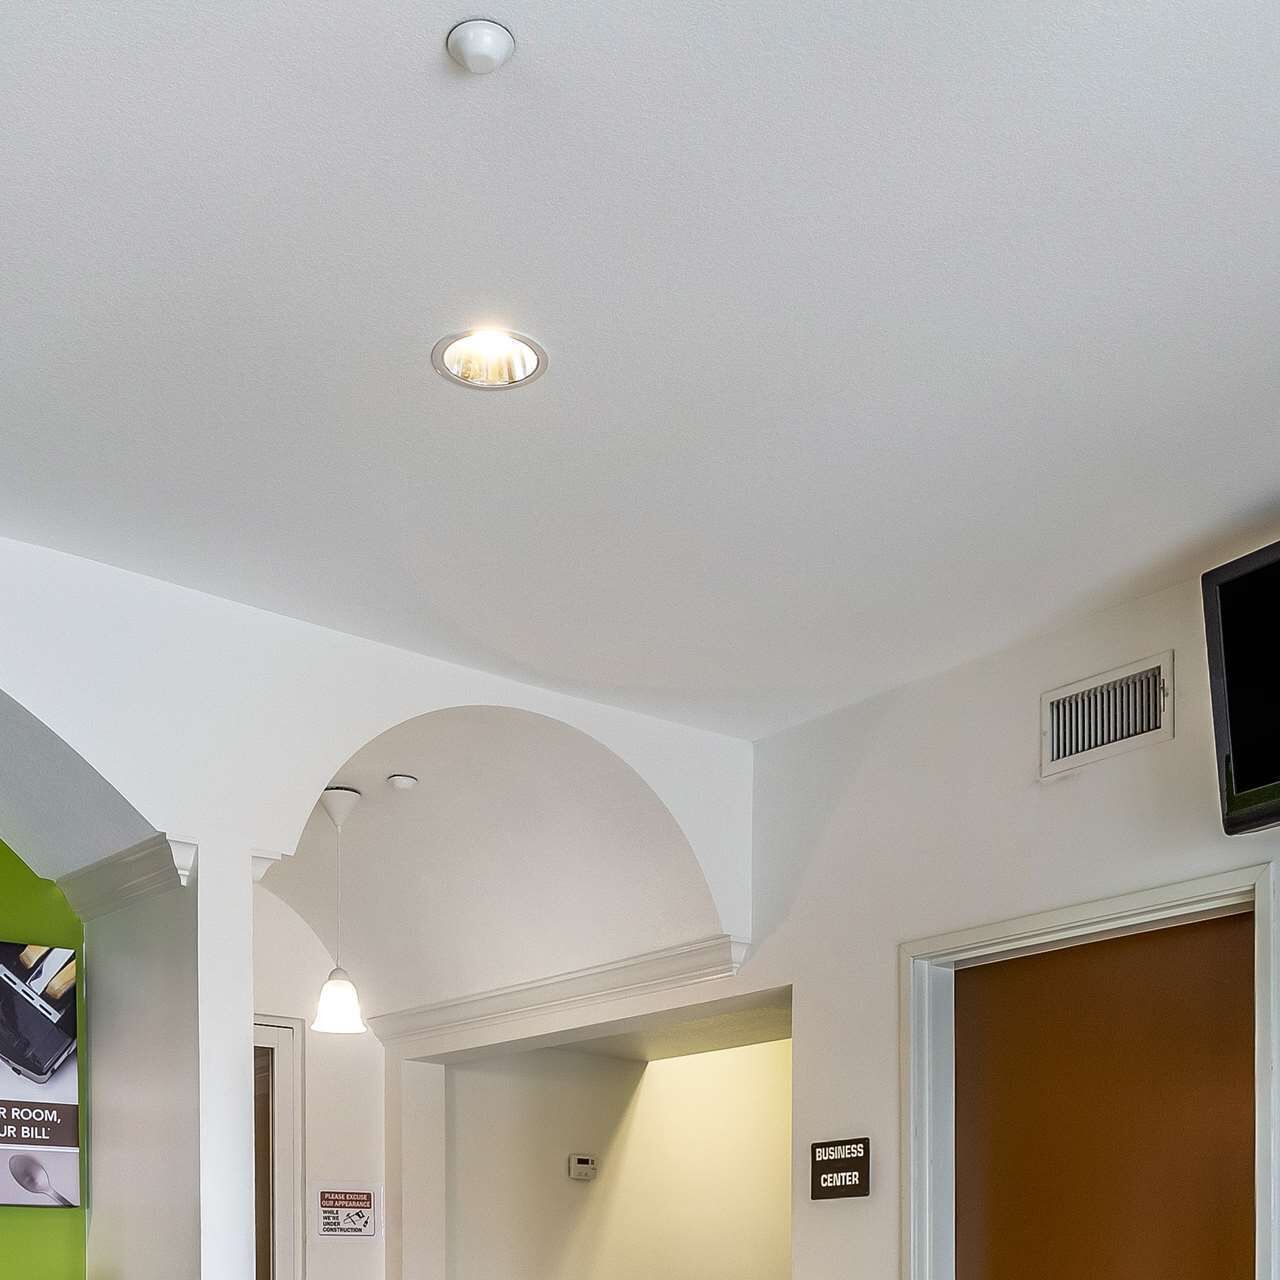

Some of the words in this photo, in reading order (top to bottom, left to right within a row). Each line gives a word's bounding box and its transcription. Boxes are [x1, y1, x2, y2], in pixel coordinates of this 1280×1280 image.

[11, 1107, 62, 1124] ROOM,
[815, 1143, 864, 1161] BUSINESS
[820, 1171, 859, 1187] CENTER
